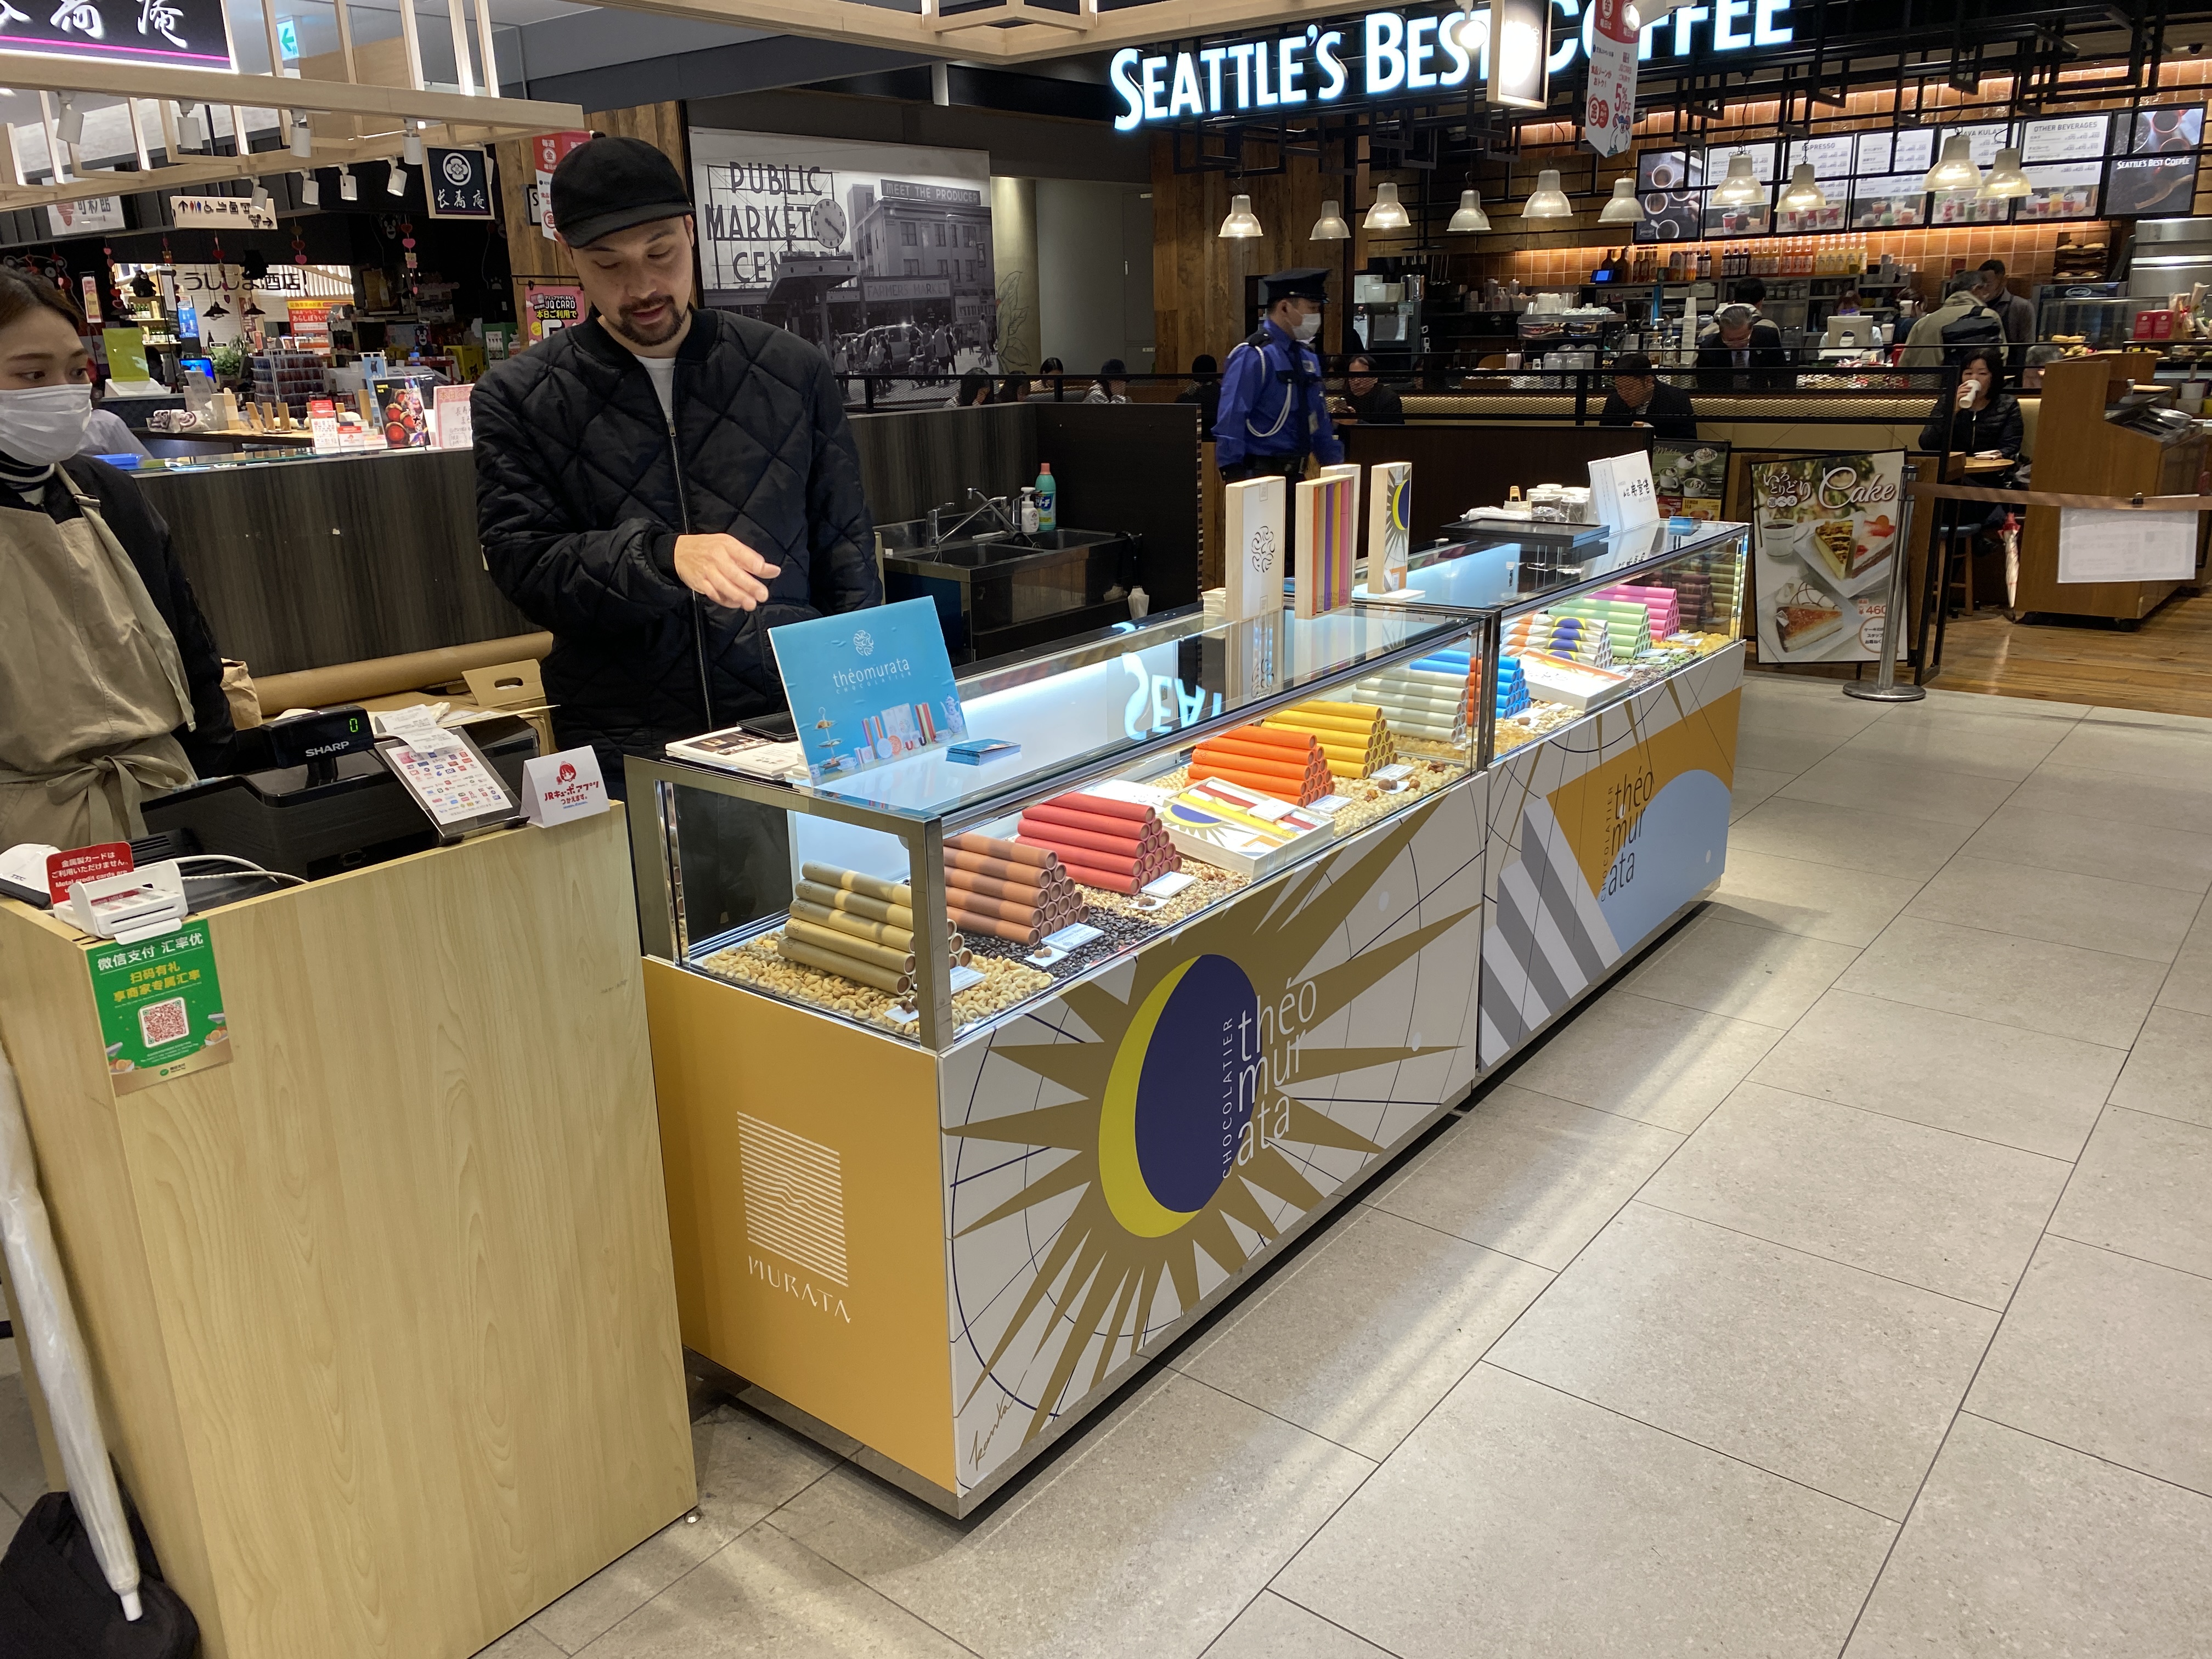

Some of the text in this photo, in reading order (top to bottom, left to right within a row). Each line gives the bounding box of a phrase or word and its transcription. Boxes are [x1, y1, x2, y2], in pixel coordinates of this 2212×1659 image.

[1110, 24, 1347, 131] SEATTLE'S
[1621, 101, 1631, 114] OFF
[2058, 121, 2097, 131] BEVERAGES
[1802, 143, 1835, 151] ESPRESSO
[730, 161, 822, 195] PUBLIC
[2117, 160, 2147, 170] SEATTLE'S
[886, 183, 978, 203] MEET THE PRODUCER
[705, 204, 811, 240] MARKET
[867, 283, 947, 297] FARMERS MARKET
[537, 310, 577, 318] 本日ご利用で
[545, 300, 575, 309] JQ CARD
[1768, 495, 1797, 507] 選べる
[1819, 467, 1896, 509] Cake
[833, 658, 910, 687] théomurata
[836, 671, 911, 695] CHOCOLATIER
[349, 718, 358, 732] 0
[306, 741, 349, 757] SHARP
[1615, 765, 1653, 820] théo
[1601, 786, 1613, 902] CHOCOLATIER
[1611, 806, 1646, 856] mur
[52, 859, 128, 878] ご利用いただけません。
[61, 851, 115, 867] 金属製カードは
[55, 879, 74, 888] Metal
[1608, 852, 1634, 896] ata
[98, 933, 203, 970] 微信支付 汇率优
[114, 969, 200, 1002] 享商家专属汇率
[129, 961, 180, 984] 扫码有礼
[1238, 977, 1316, 1062] théo
[1239, 1029, 1306, 1113] mur
[1223, 1018, 1233, 1179] CHOCOLATIER
[1237, 1096, 1289, 1166] ata
[749, 1255, 850, 1323] MURATA
